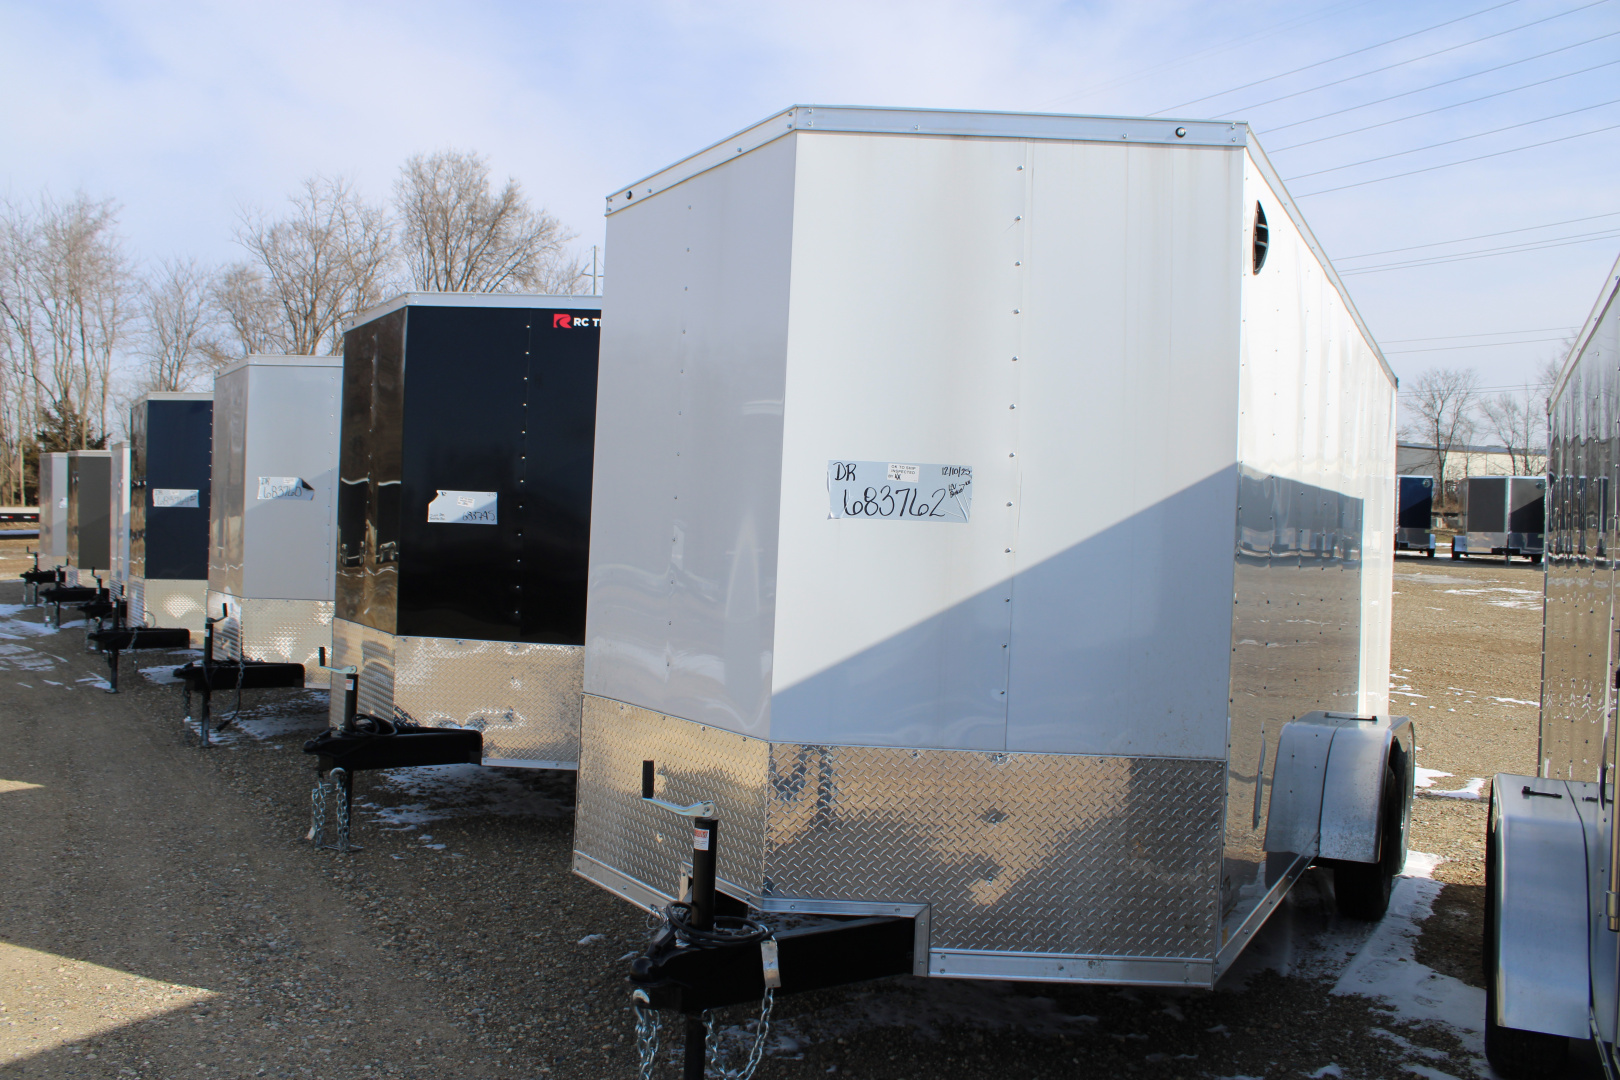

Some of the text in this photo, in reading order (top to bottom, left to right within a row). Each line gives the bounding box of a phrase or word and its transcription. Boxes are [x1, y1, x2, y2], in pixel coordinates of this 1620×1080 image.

[573, 317, 590, 327] RC
[833, 461, 857, 481] DR
[263, 485, 303, 499] 683760
[843, 485, 947, 517] 683762
